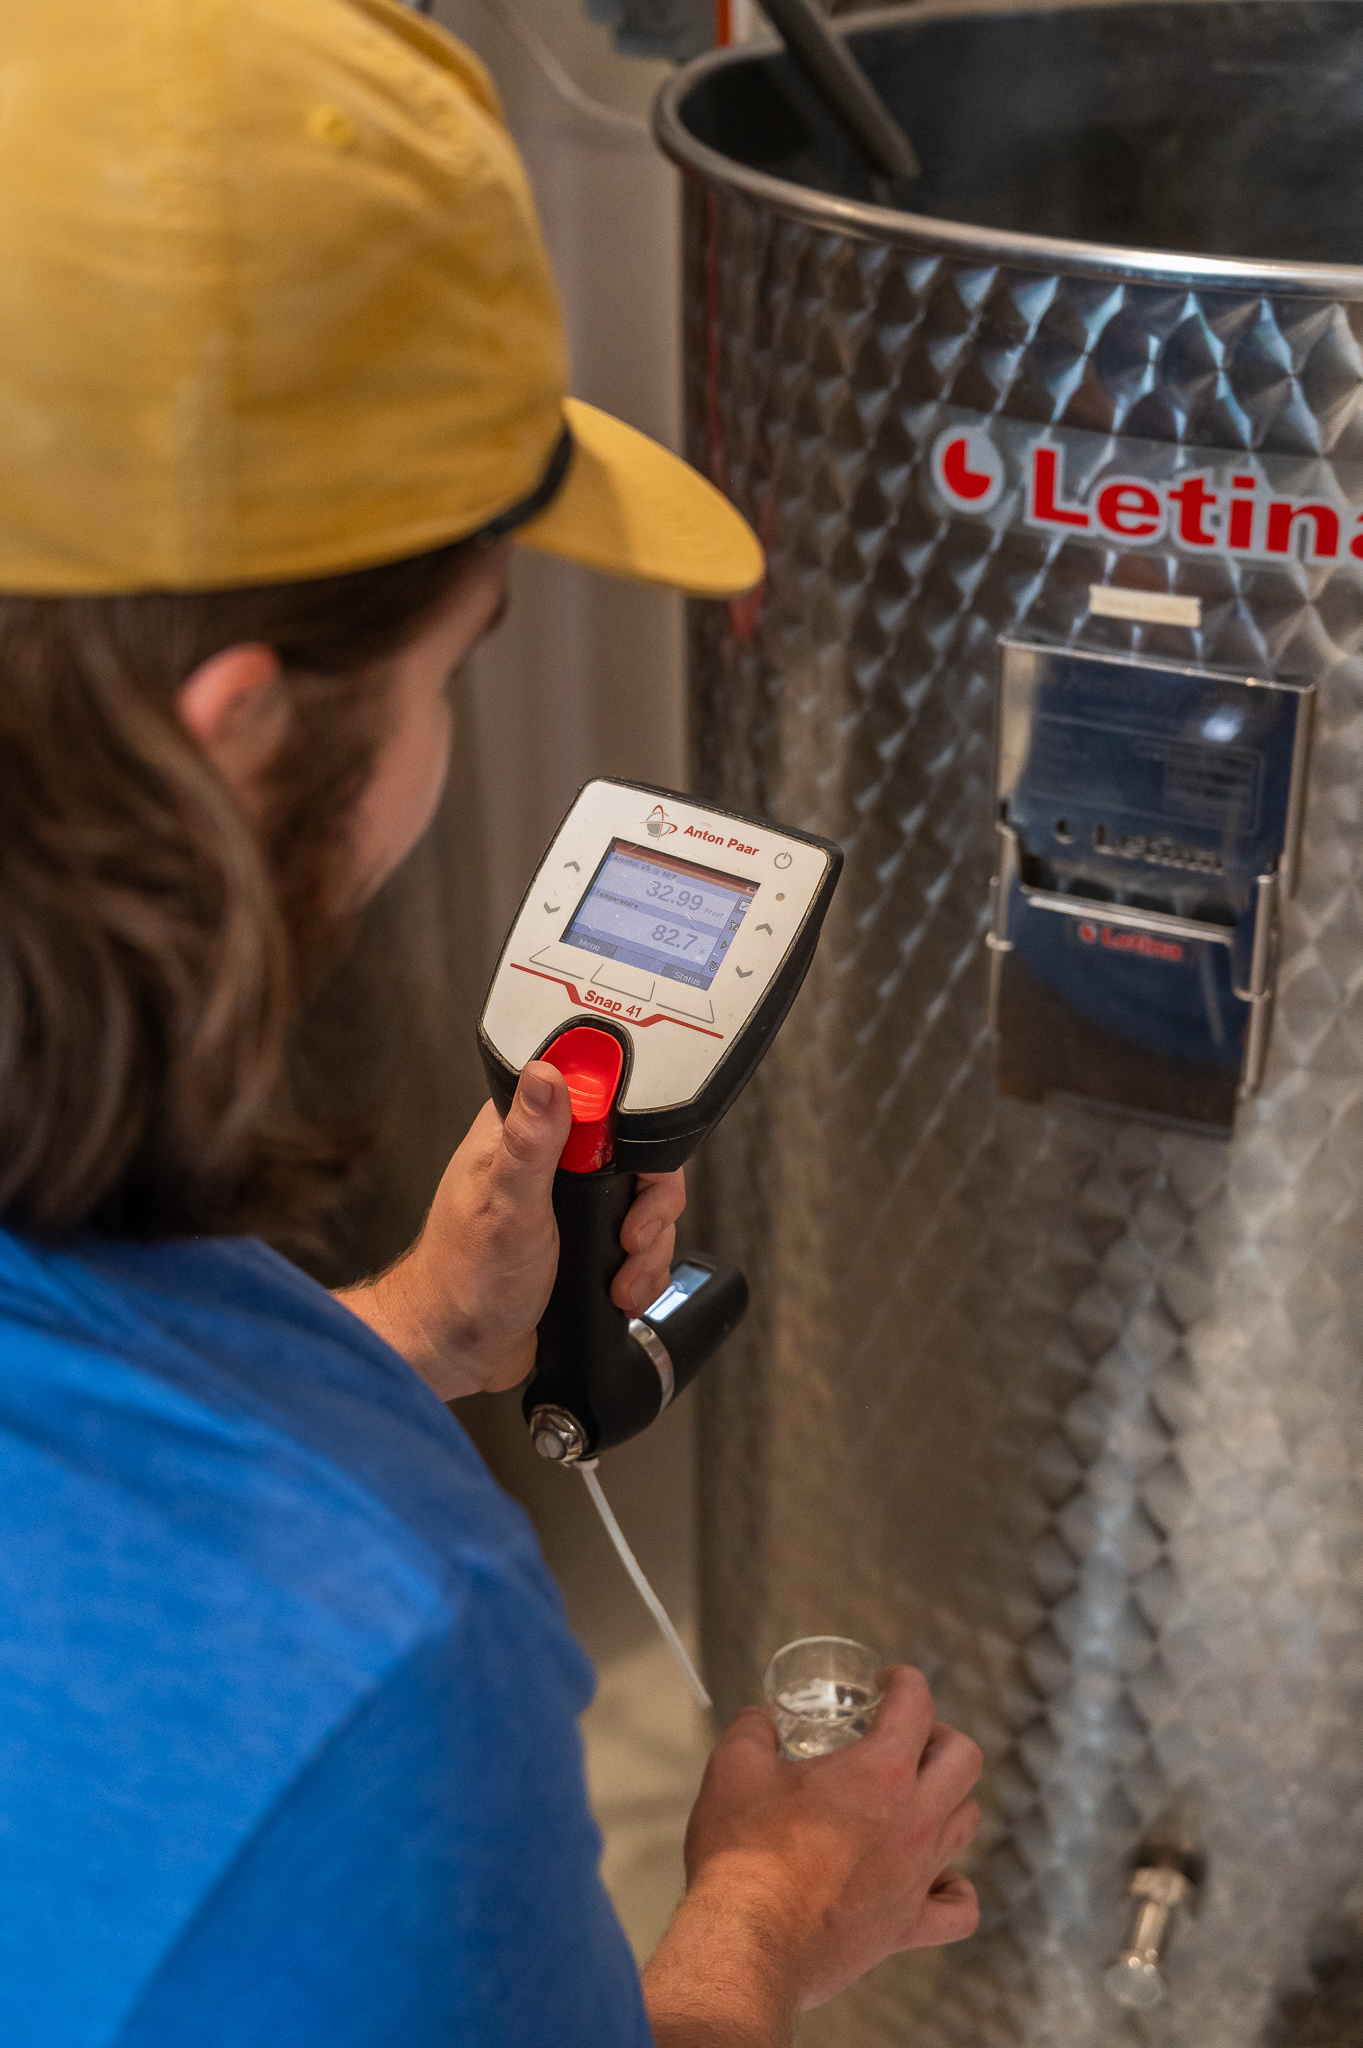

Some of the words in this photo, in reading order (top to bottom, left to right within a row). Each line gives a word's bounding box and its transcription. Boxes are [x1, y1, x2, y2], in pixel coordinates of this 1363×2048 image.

[1032, 448, 1363, 562] Letin
[683, 825, 725, 846] Anton
[726, 837, 760, 857] Paar
[613, 854, 640, 868] Alcohol
[641, 864, 651, 872] US
[595, 889, 640, 910] Temperature
[645, 880, 704, 912] 32.99
[703, 908, 724, 919] Proof
[578, 938, 601, 952] Menu
[651, 924, 699, 950] 82.7
[673, 970, 702, 987] Status
[584, 989, 623, 1013] Snap
[625, 1004, 643, 1019] 41
